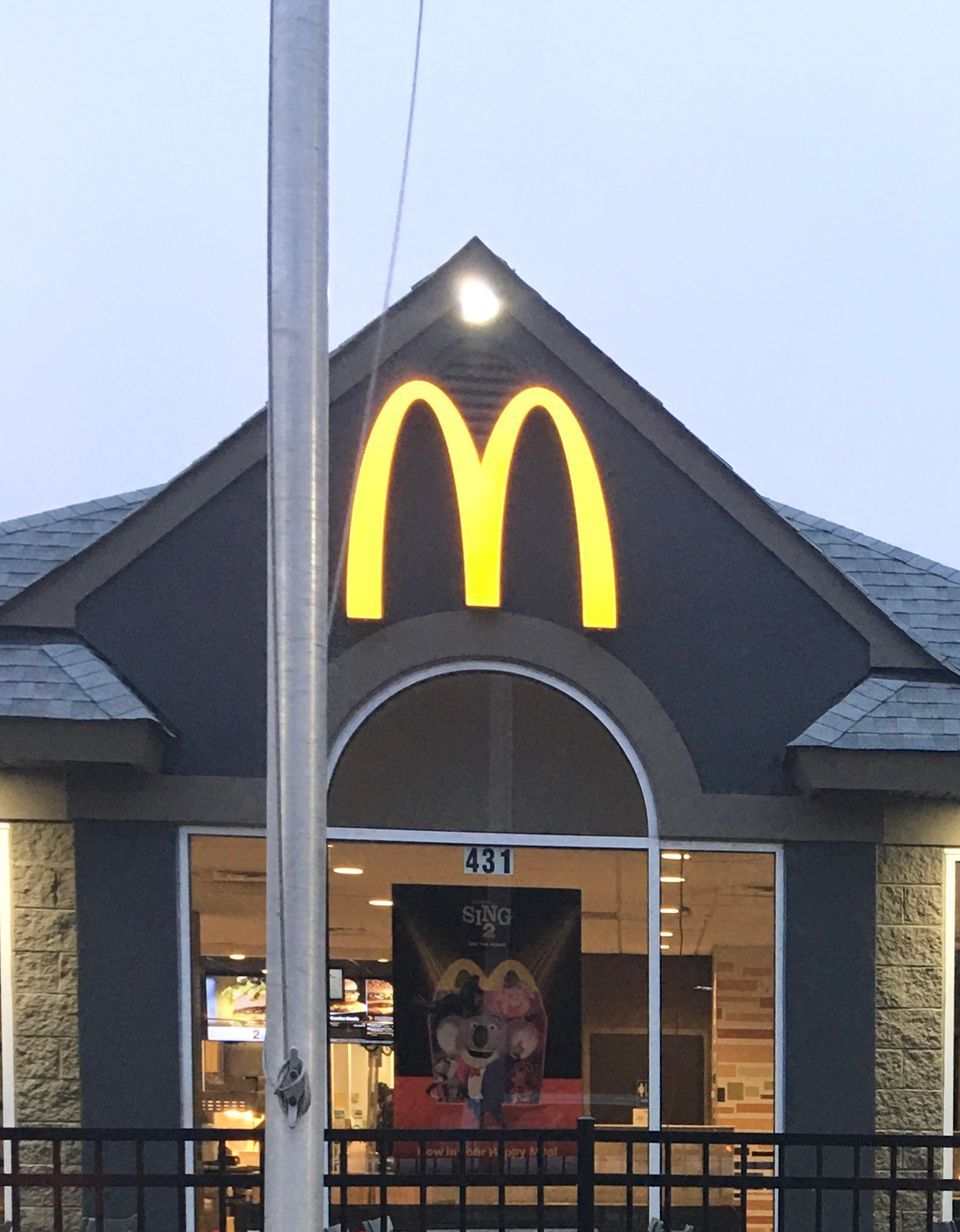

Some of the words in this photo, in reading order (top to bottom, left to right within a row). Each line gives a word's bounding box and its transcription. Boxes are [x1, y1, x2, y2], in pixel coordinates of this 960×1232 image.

[465, 848, 512, 874] 431
[462, 904, 512, 925] SING
[482, 922, 496, 939] 2
